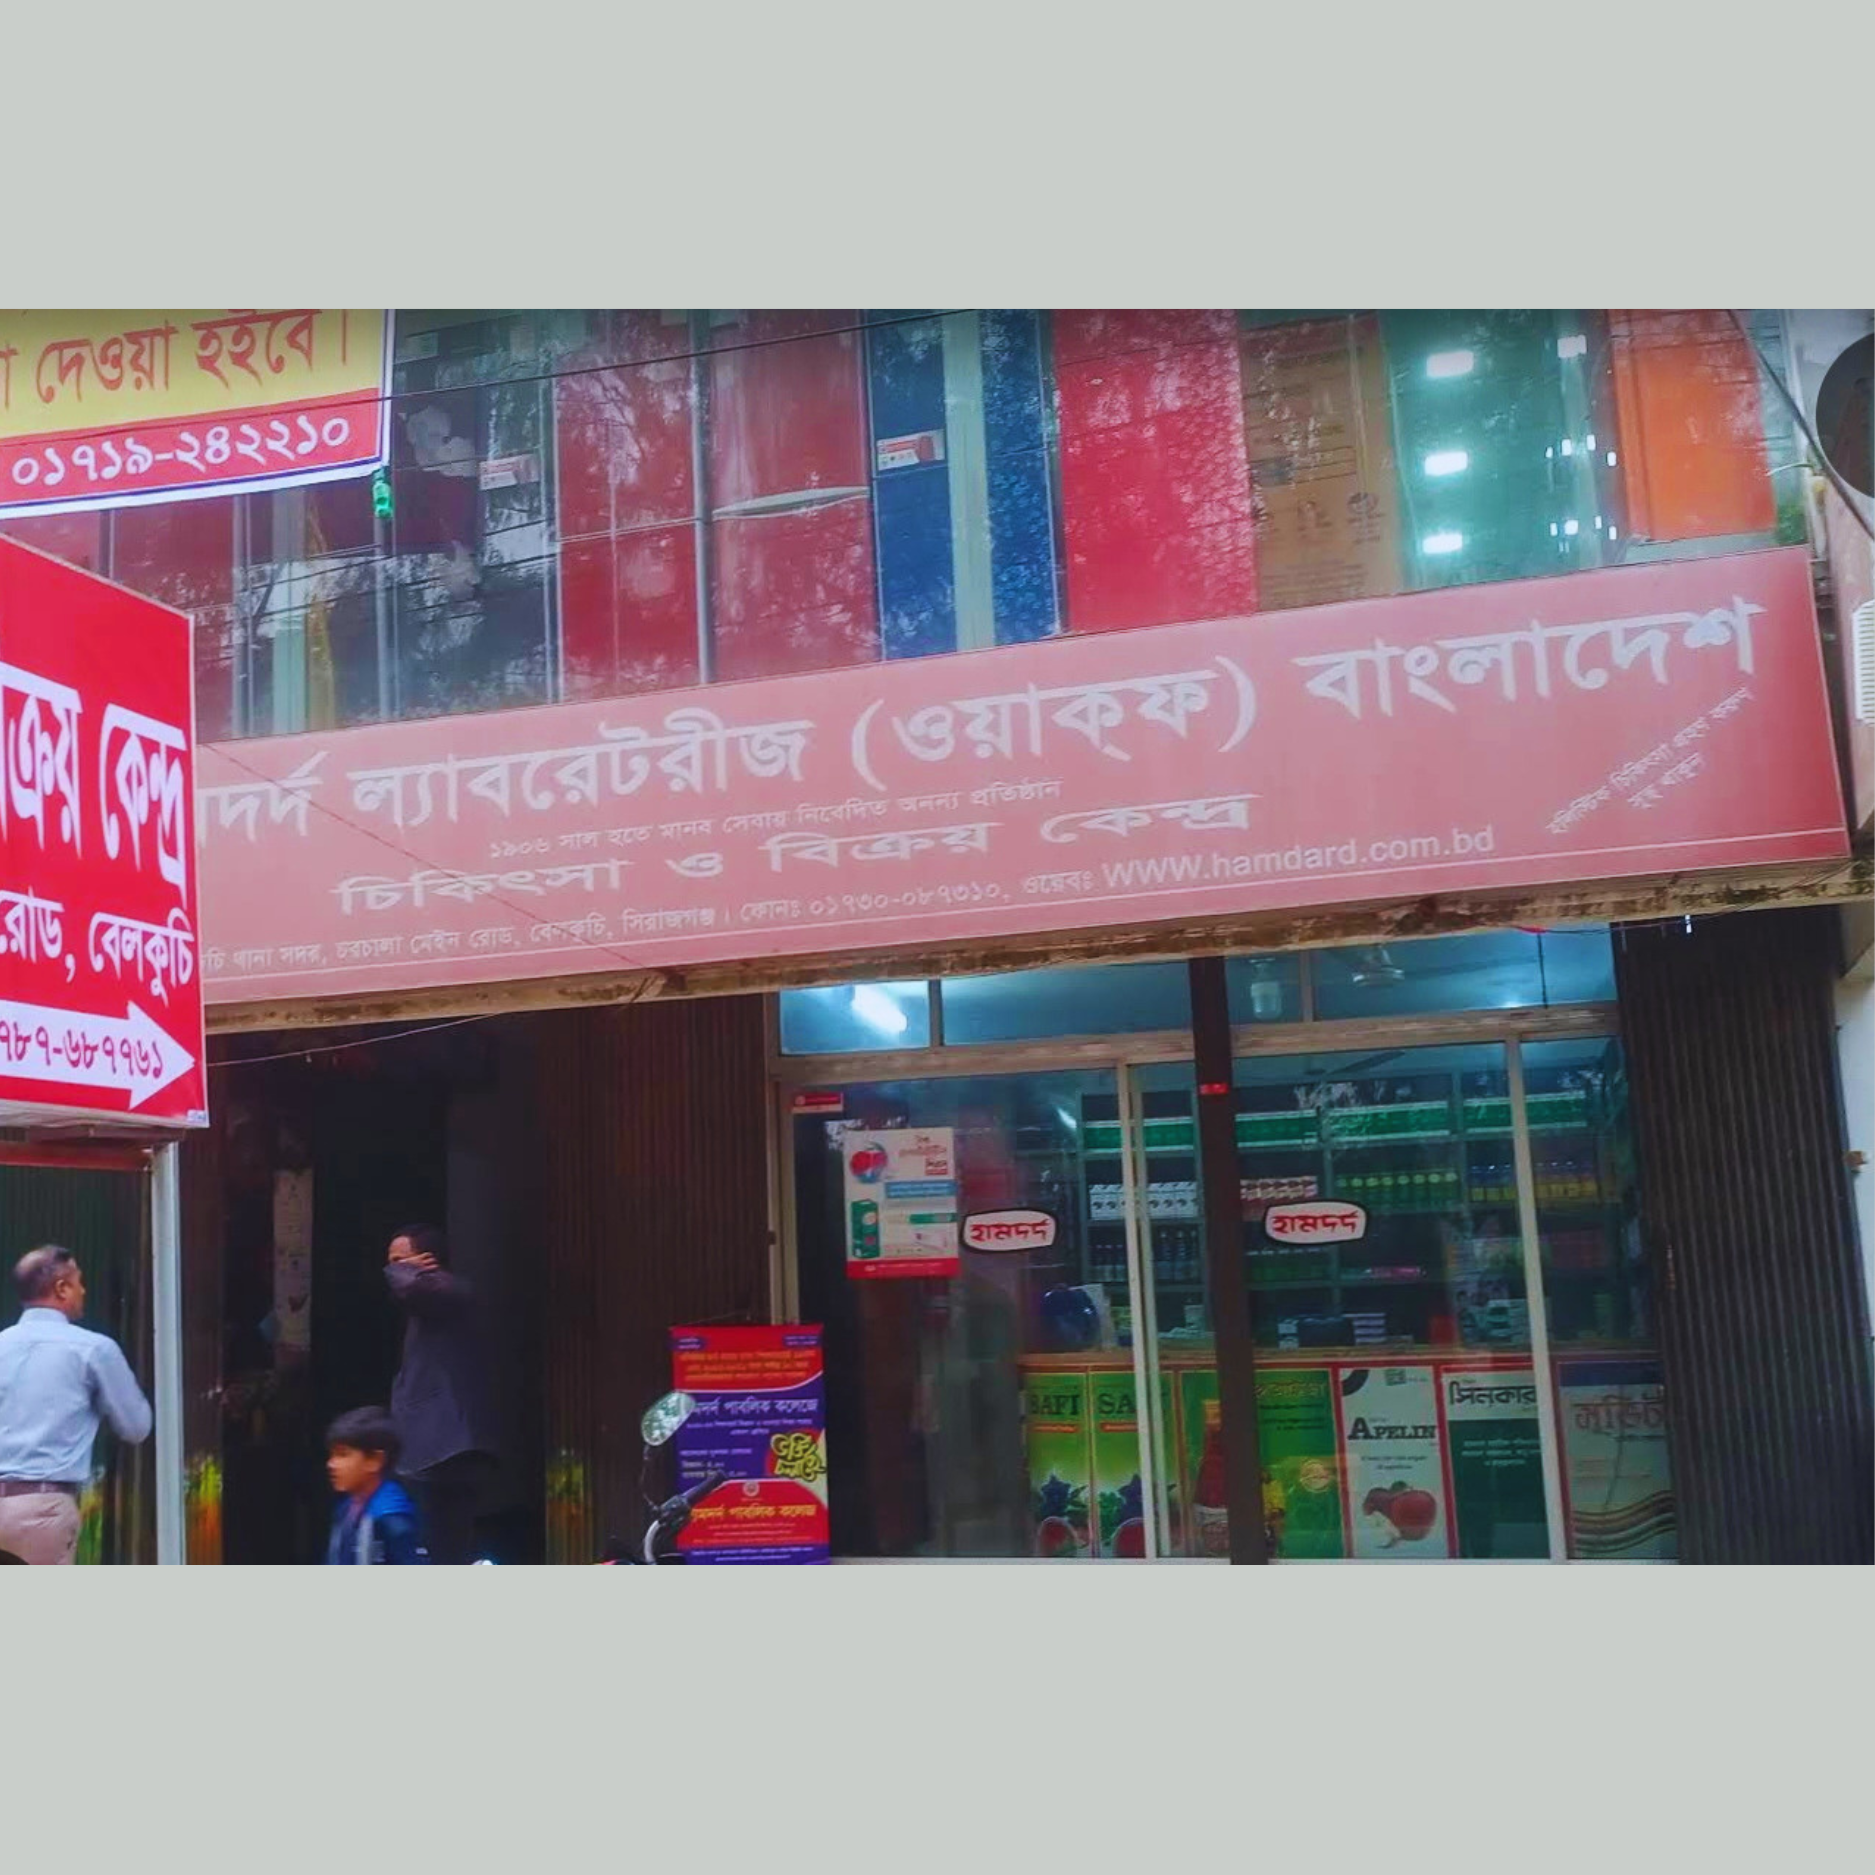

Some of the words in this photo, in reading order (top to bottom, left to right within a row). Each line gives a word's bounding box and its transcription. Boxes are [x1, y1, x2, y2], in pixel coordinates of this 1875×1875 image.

[36, 319, 179, 404] দেওয়া
[12, 415, 349, 486] ০১৭১৯-২৪২২১০
[197, 750, 330, 848] দর্দ
[347, 706, 815, 829] ল্যাবরেটরীজ
[1292, 594, 1767, 721] বাংলাদেশ
[0, 660, 83, 861] ক্রয়
[99, 702, 187, 908] কেন্দ্র
[490, 837, 551, 859] ১৯০৬
[559, 830, 601, 850] সাল
[606, 824, 652, 848] হতে
[659, 818, 716, 841] মানব
[795, 797, 892, 825] নিবেদিত
[898, 791, 964, 813] অনন্য
[970, 776, 1065, 808] প্রতিষ্ঠান
[330, 857, 635, 917] চিকিৎসা
[665, 851, 724, 878] ও
[758, 821, 1005, 874] বিক্রয়
[1040, 793, 1263, 845] কেন্দ্র
[88, 906, 194, 1007] বেলকুচি
[970, 1218, 1050, 1243] হামদর্দ
[1272, 1211, 1359, 1234] হামদর্দ
[1099, 1392, 1136, 1415] SA
